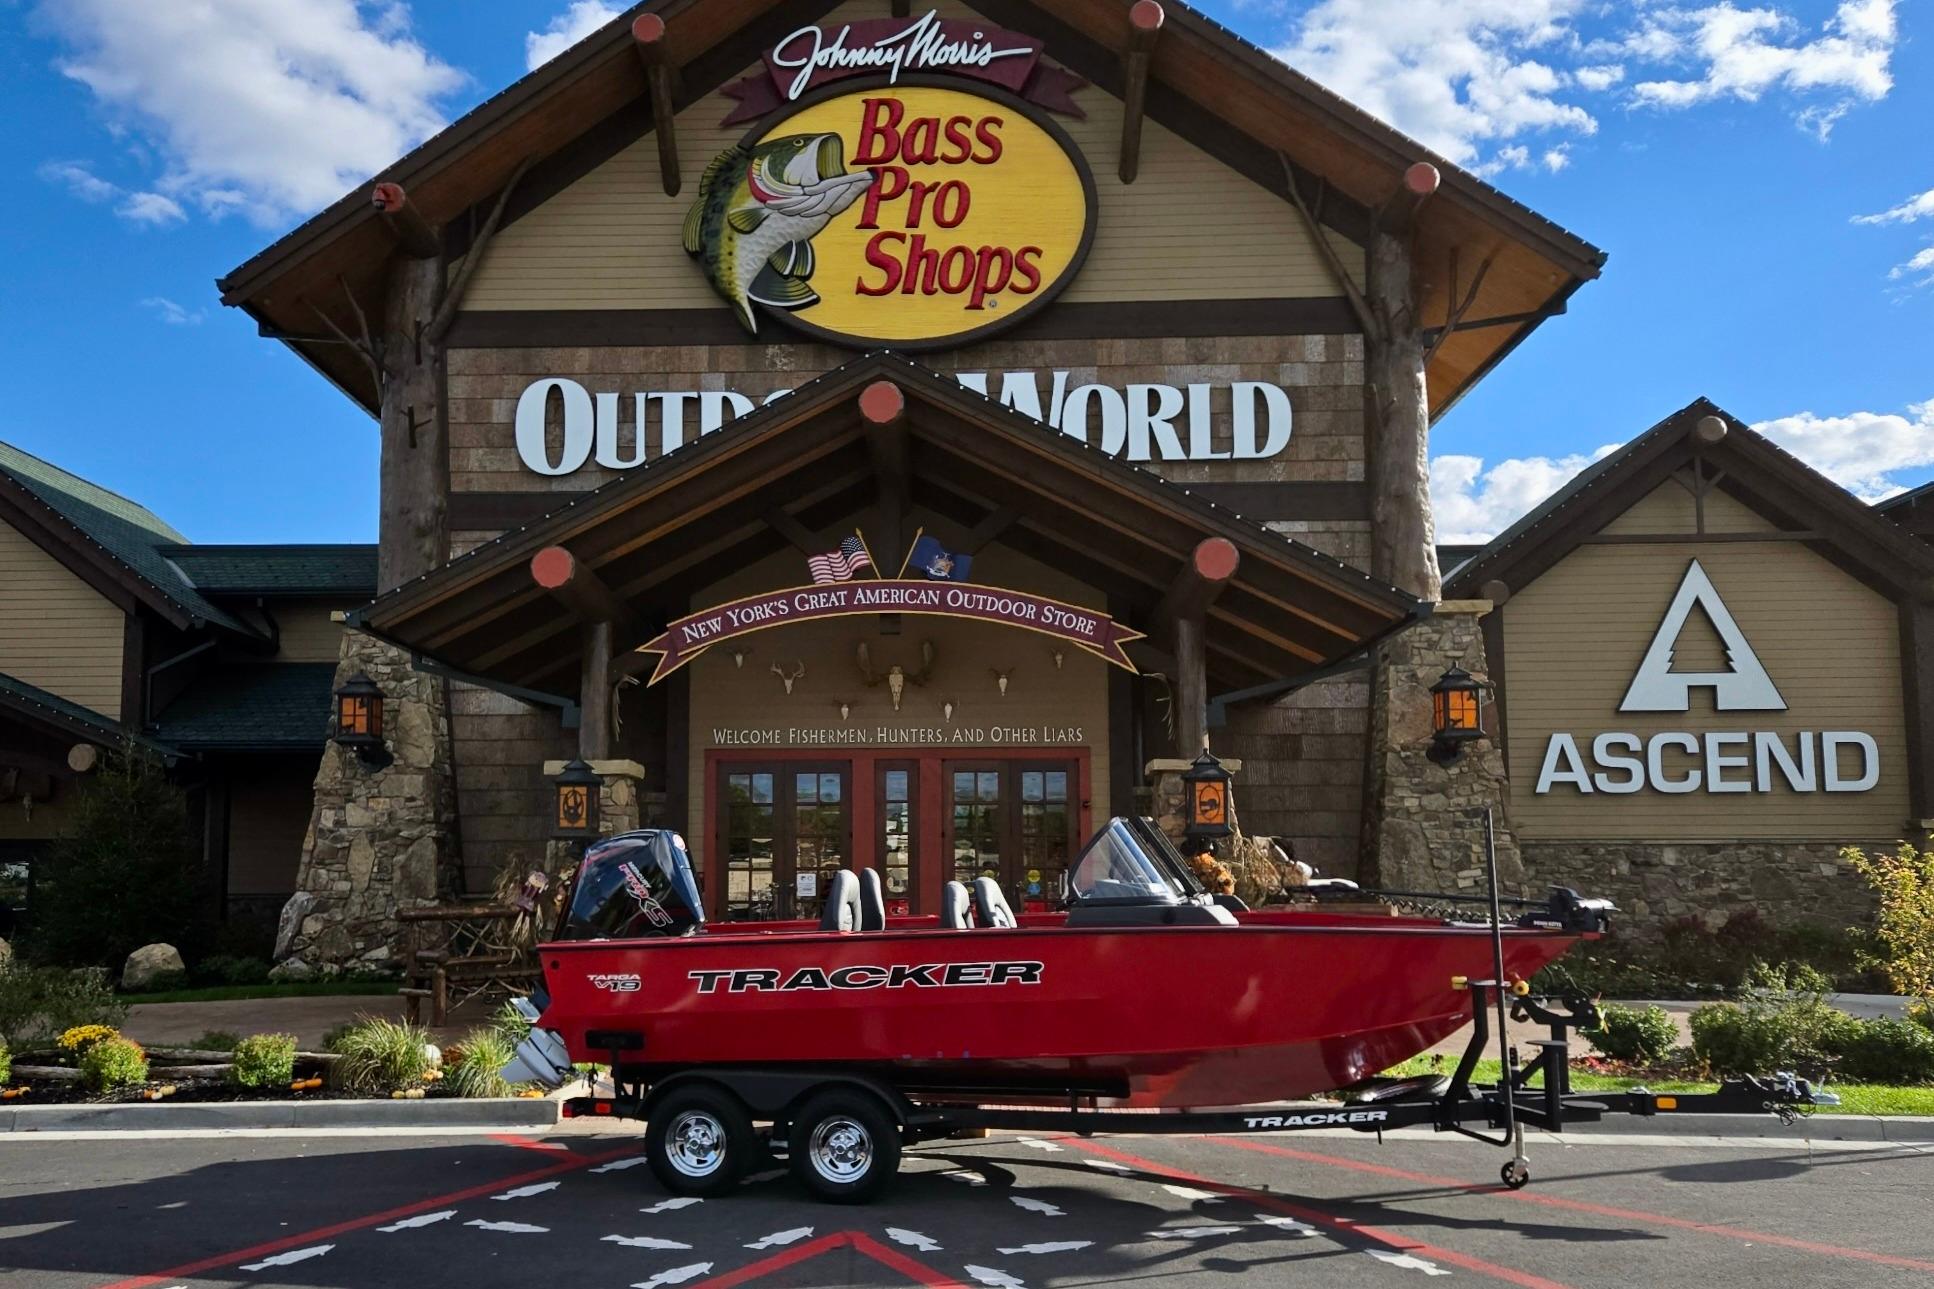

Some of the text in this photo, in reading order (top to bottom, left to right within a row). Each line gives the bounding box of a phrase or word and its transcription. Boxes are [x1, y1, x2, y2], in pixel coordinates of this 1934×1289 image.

[773, 9, 1033, 100] Johnny Morris
[850, 98, 1003, 166] Bass
[855, 166, 971, 230] Pro
[855, 231, 1043, 311] Shops
[681, 587, 1097, 644] NEW YORK'S GREAT AMERICAN OUTDOOR STORE
[713, 726, 1083, 744] WELCOME FISHERMEN, HUNTERS, AND OTHER LIARS
[1535, 731, 1880, 793] ASCEND
[594, 980, 642, 992] V19
[688, 961, 1045, 993] TRACKER
[1244, 1110, 1388, 1128] TRACKER
